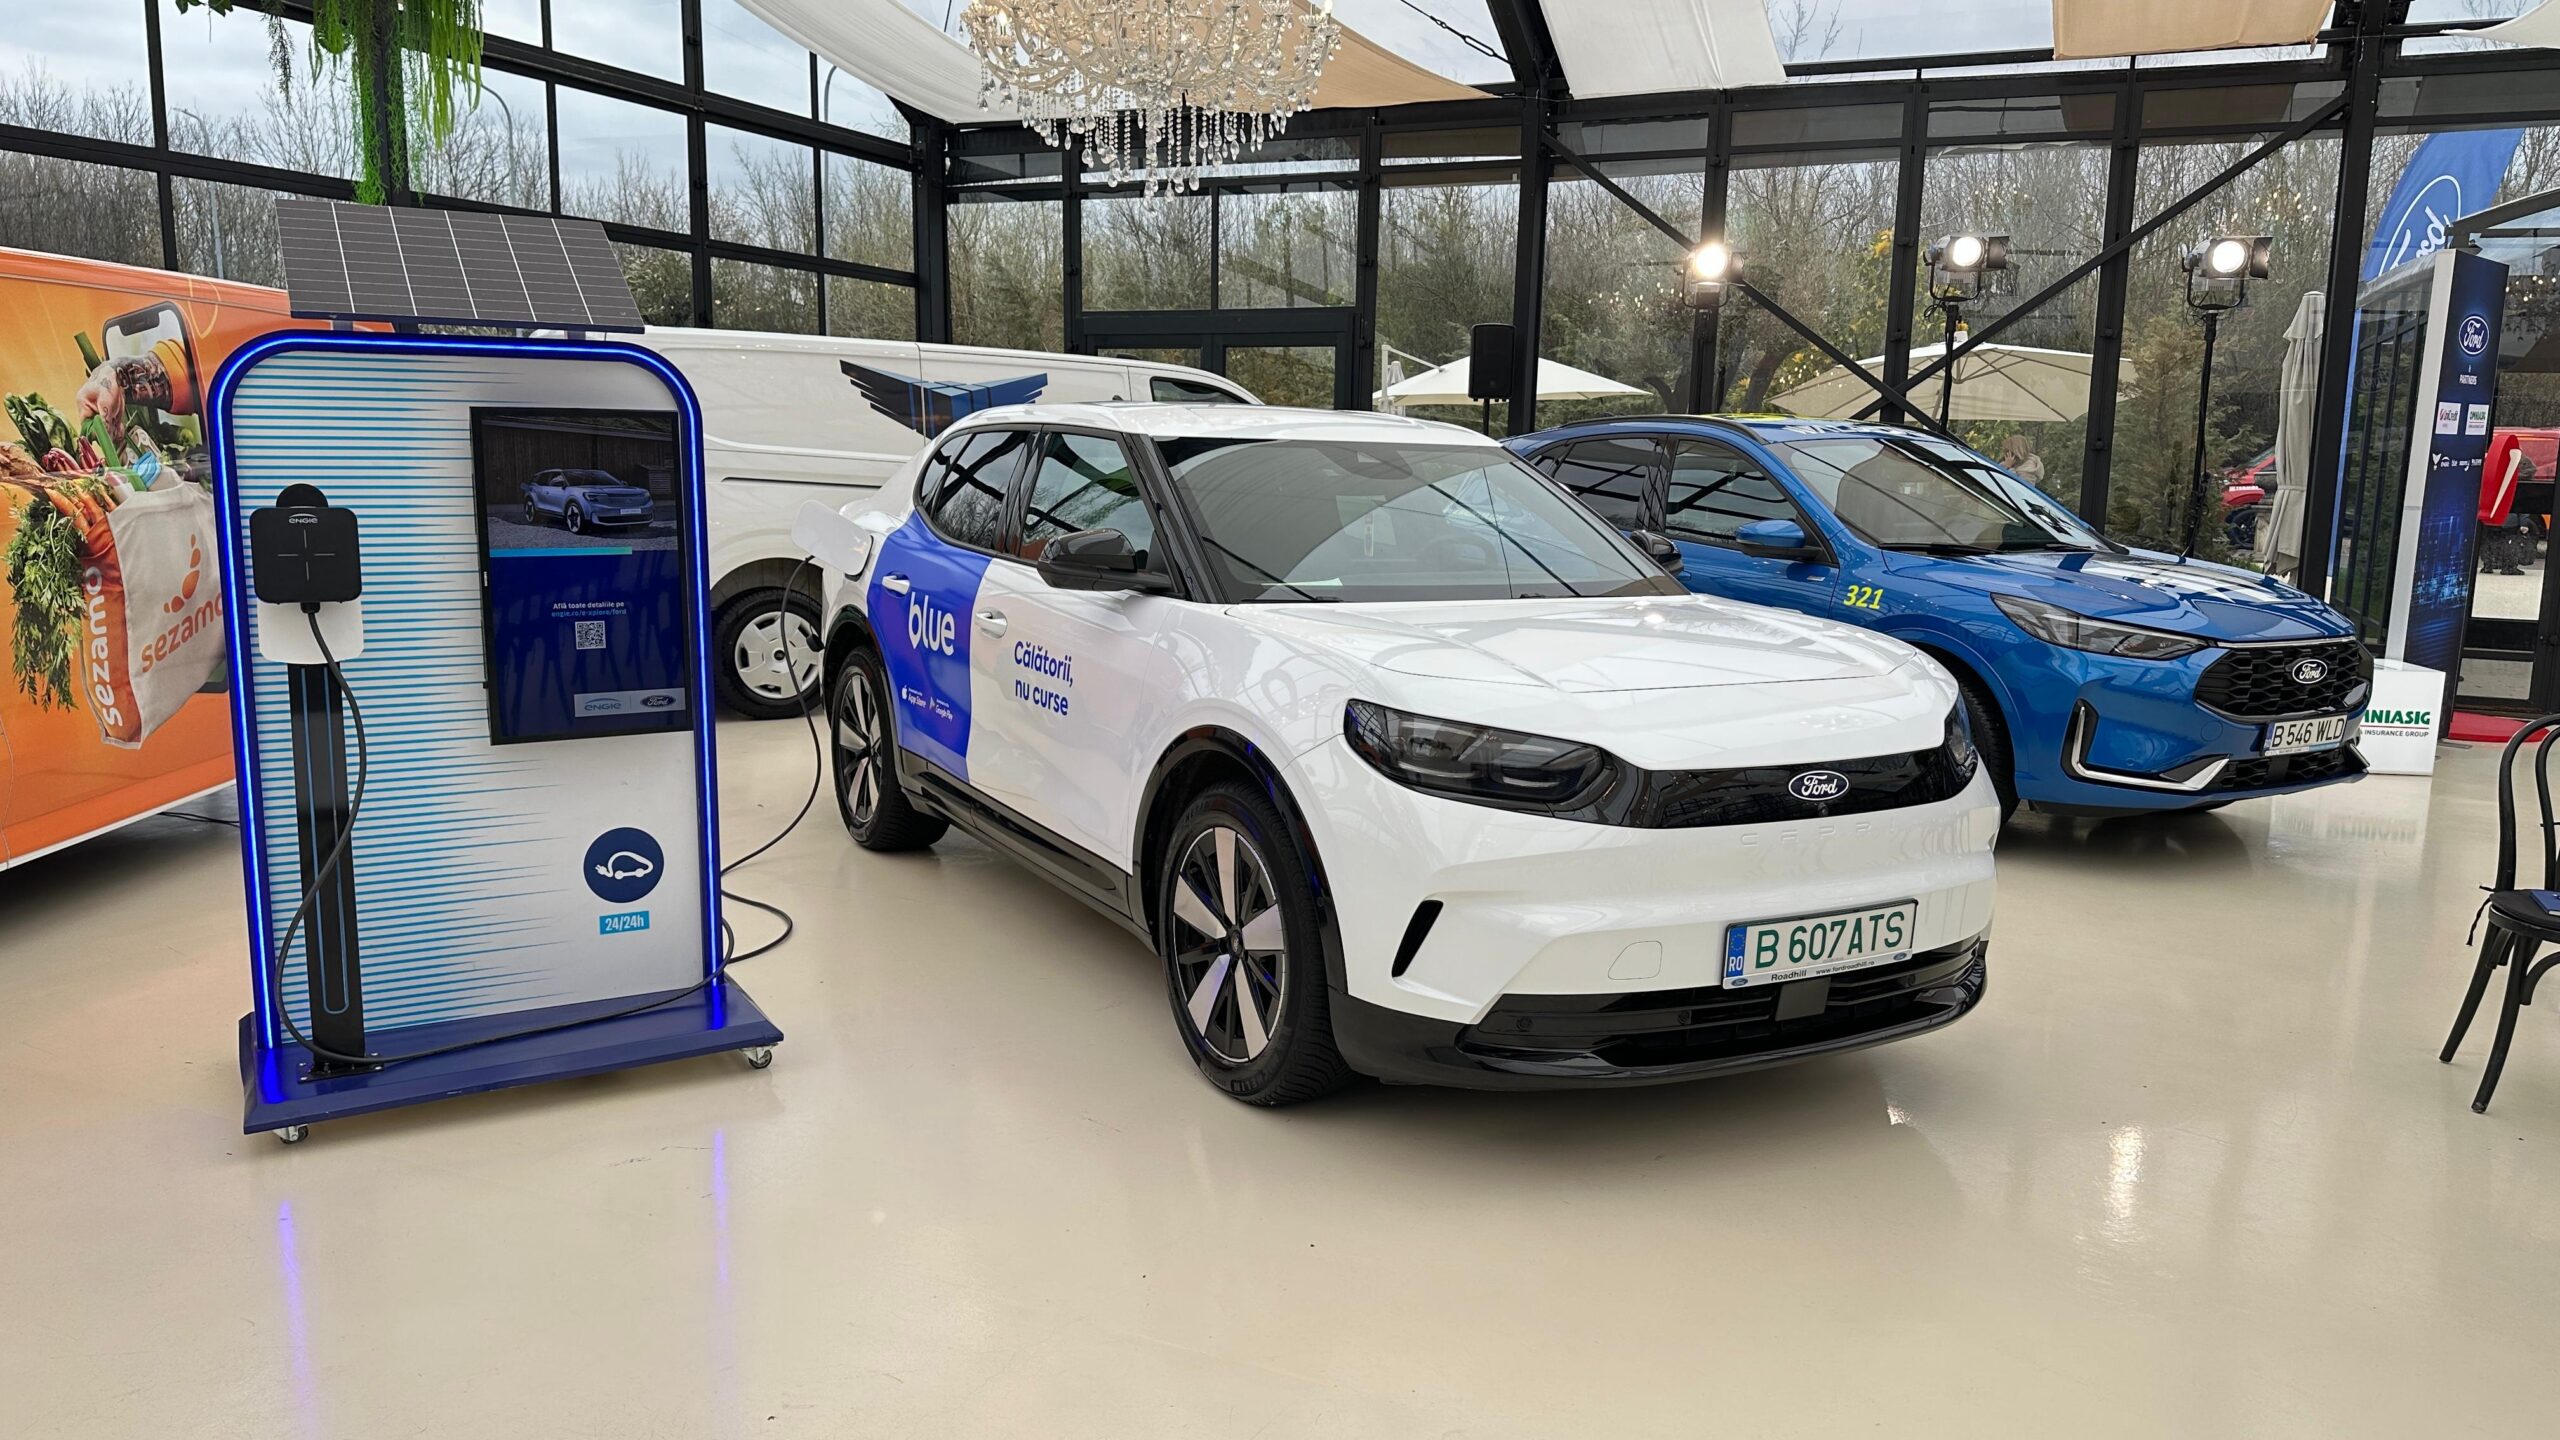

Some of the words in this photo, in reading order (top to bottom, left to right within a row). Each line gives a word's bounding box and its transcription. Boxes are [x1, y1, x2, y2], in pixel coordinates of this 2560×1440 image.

[2463, 320, 2485, 349] Ford
[1843, 584, 1884, 609] 321
[908, 591, 955, 656] blue
[85, 566, 123, 727] sezamo
[1013, 640, 1074, 687] Călătorii,
[2299, 663, 2321, 680] Ford
[647, 696, 669, 706] Ford
[1015, 677, 1029, 702] nu
[1032, 684, 1069, 716] curse
[2364, 709, 2431, 725] NIASIG
[2273, 726, 2285, 748] B
[2286, 722, 2314, 746] 546
[2316, 719, 2344, 742] WLD
[1801, 775, 1838, 797] Ford
[605, 914, 645, 932] 24/24h
[1755, 929, 1780, 969] B
[1728, 956, 1744, 973] RO
[1771, 969, 1808, 981] Roadhill
[1815, 960, 1875, 975] www.fordroadhill.ro
